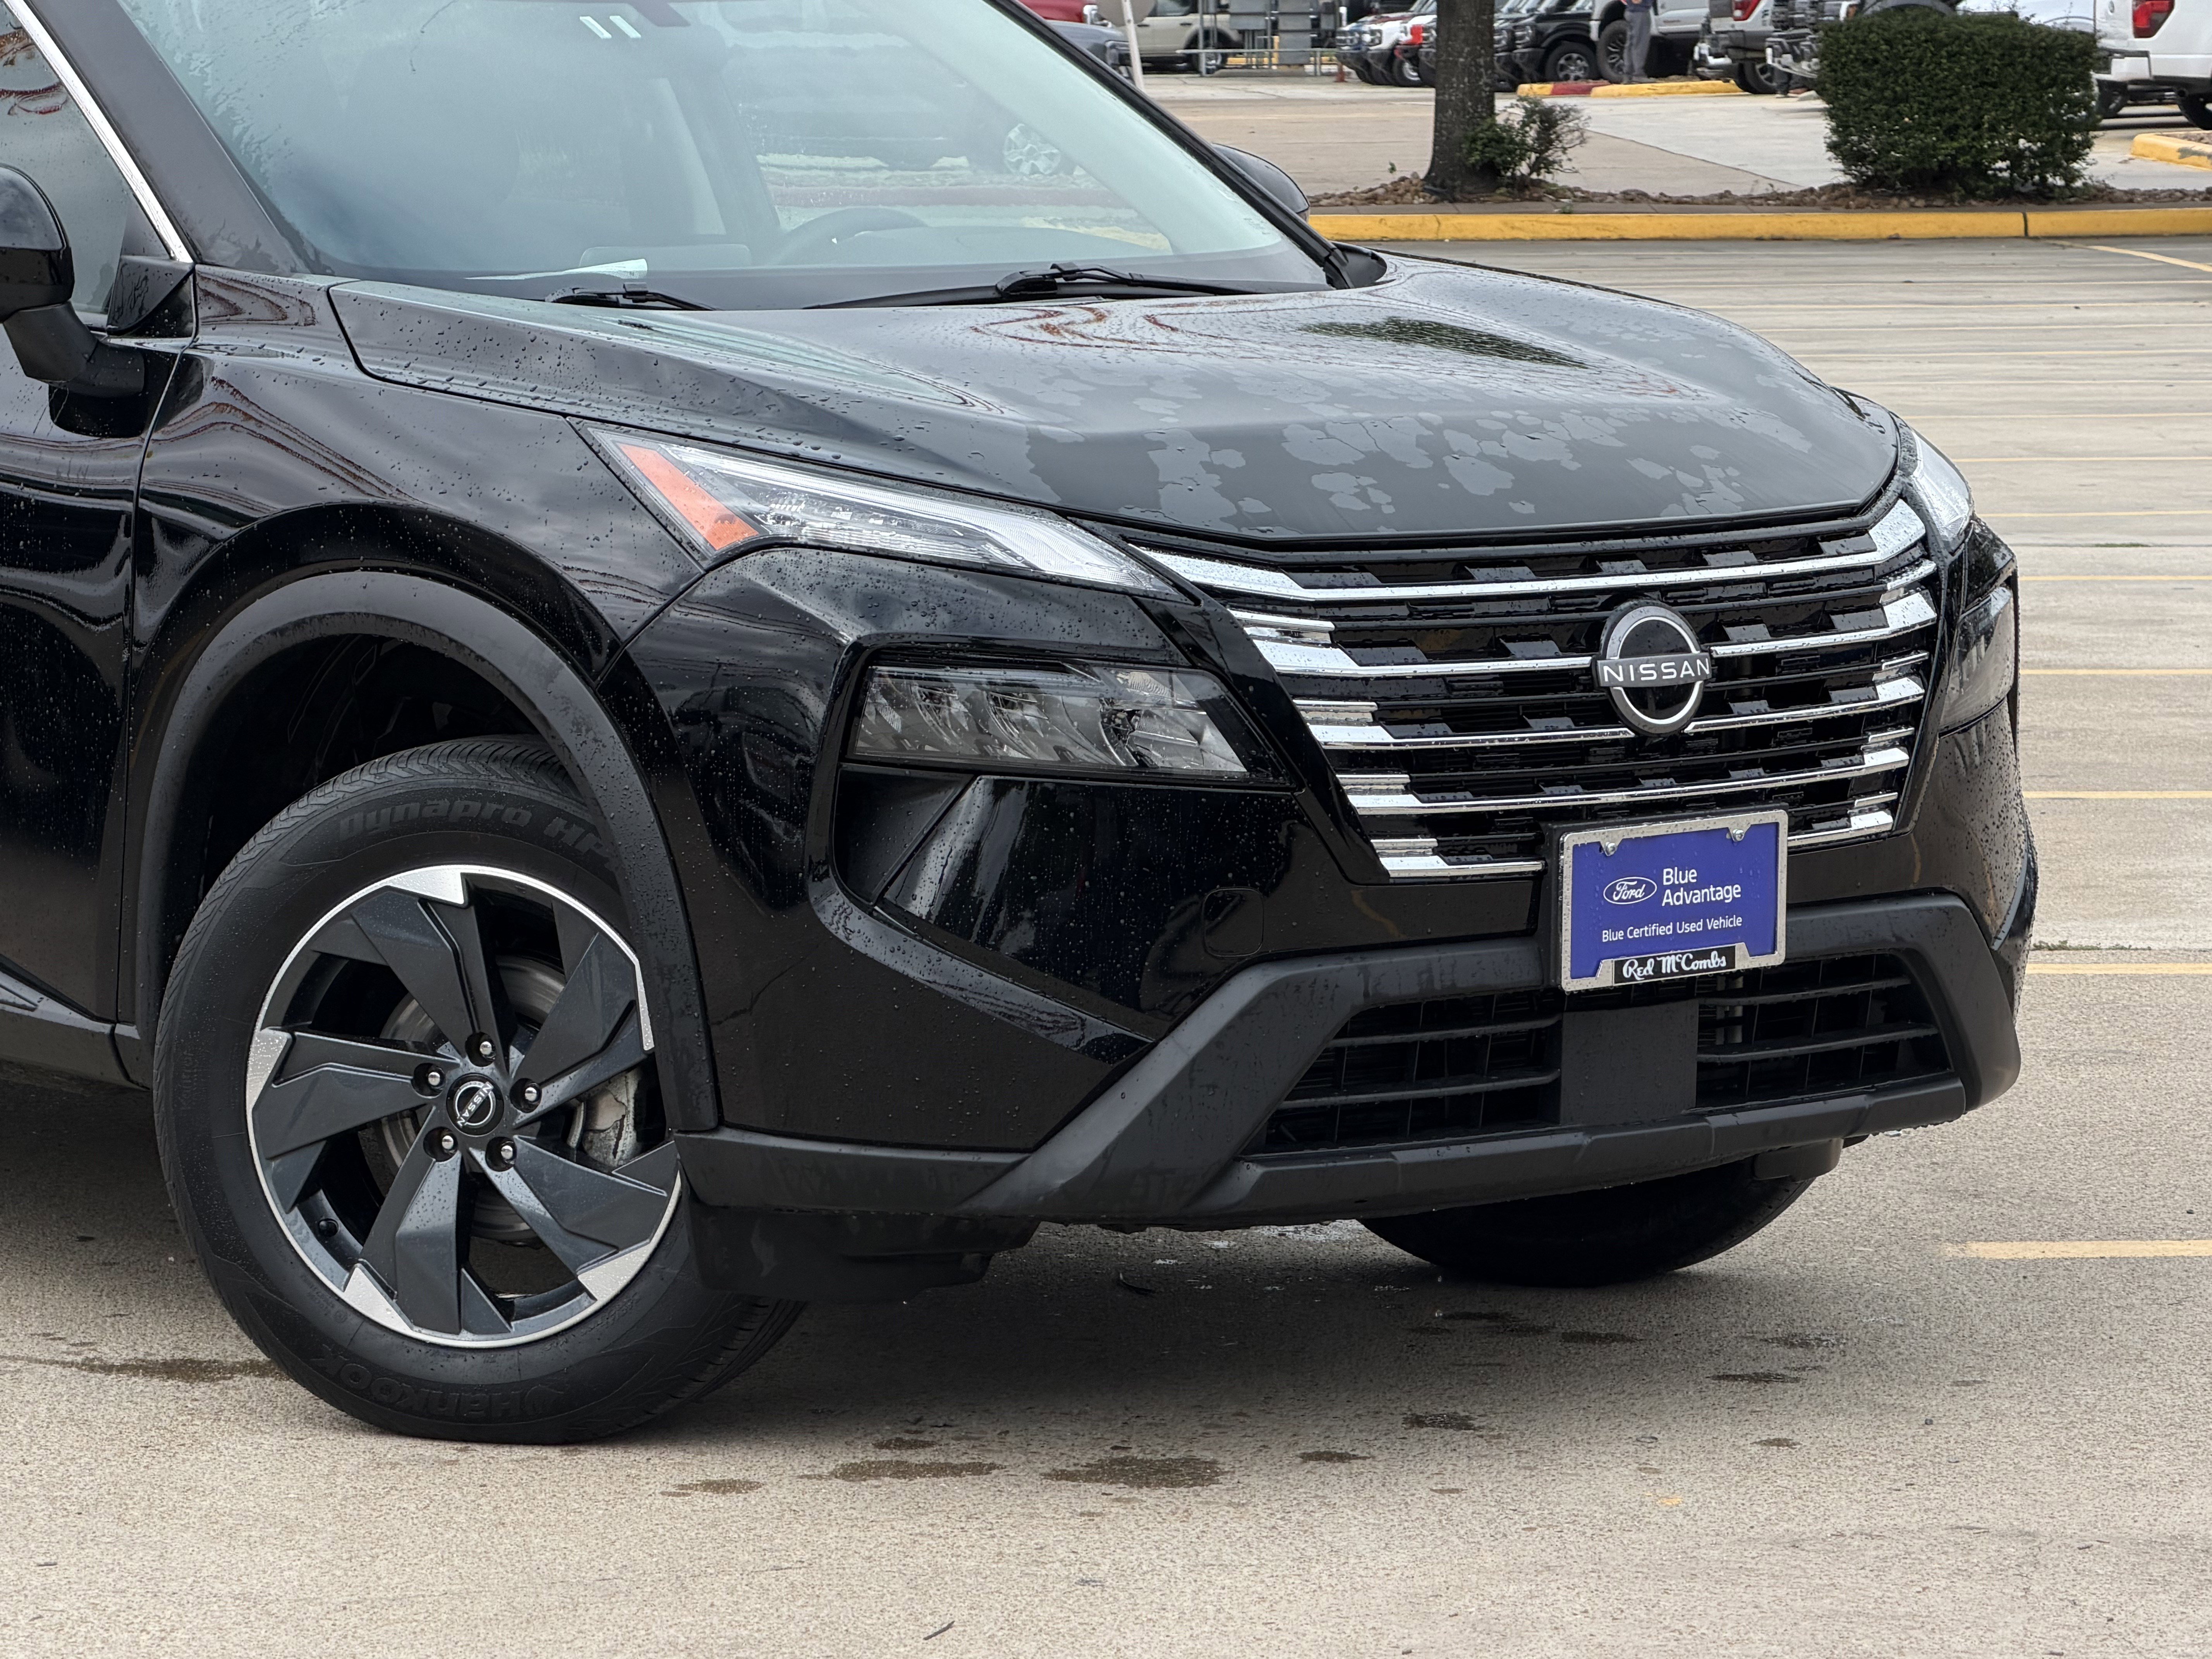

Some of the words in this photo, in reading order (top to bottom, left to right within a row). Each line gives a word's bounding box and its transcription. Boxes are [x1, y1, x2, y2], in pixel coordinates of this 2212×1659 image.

[1603, 658, 1710, 682] NISSAN
[1663, 867, 1697, 885] Blue
[1613, 881, 1645, 901] Ford
[1662, 884, 1741, 906] Advantage
[1602, 929, 1624, 942] Blue
[1627, 922, 1673, 939] Certified
[1676, 919, 1703, 933] Used
[1707, 915, 1742, 930] Vehicle
[1623, 958, 1654, 981] Red
[1657, 951, 1727, 973] McCombs
[457, 1083, 493, 1127] NISSAN
